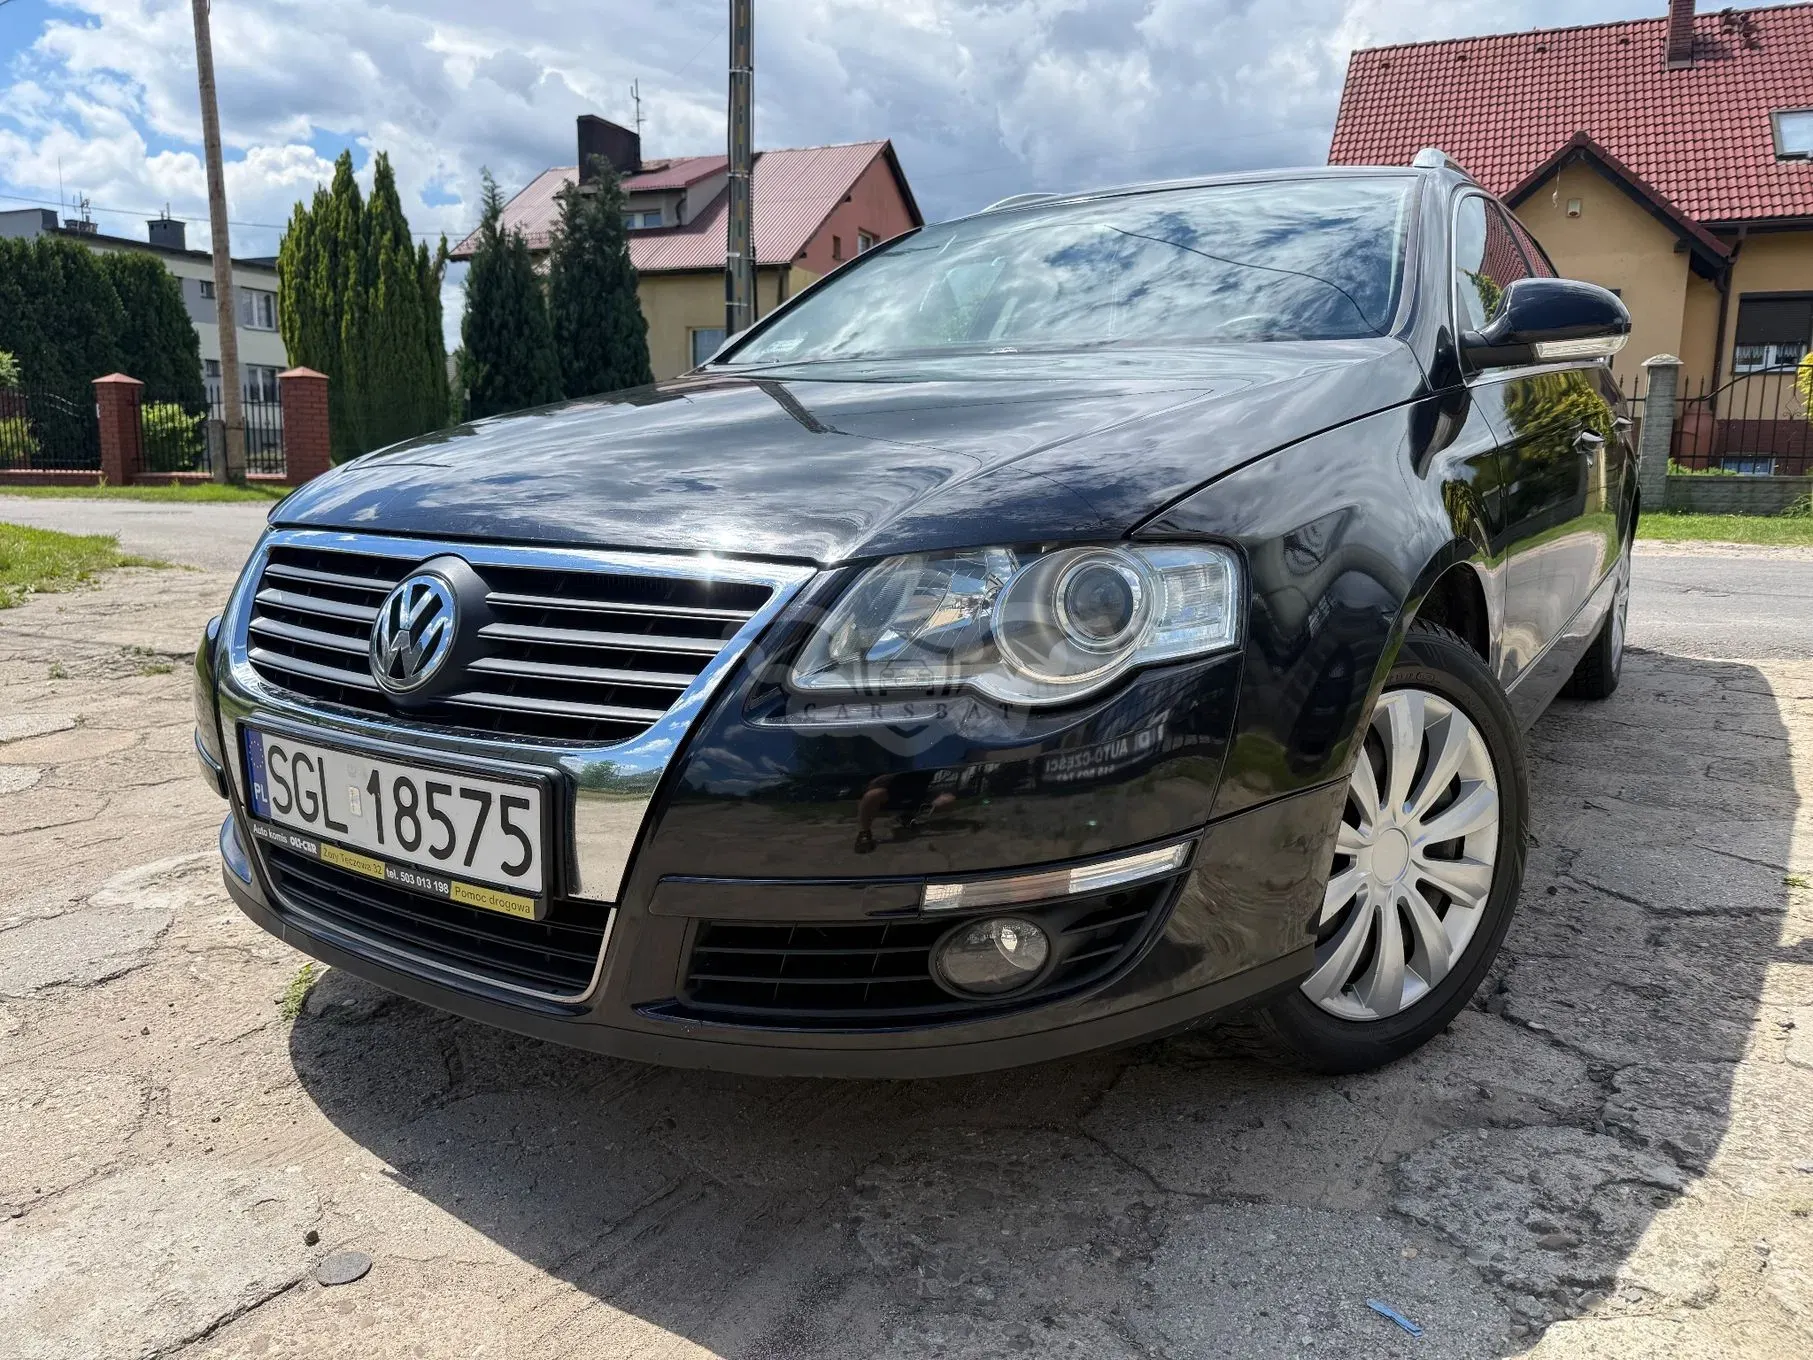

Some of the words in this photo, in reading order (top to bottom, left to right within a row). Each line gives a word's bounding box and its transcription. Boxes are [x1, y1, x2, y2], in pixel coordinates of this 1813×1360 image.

[254, 783, 268, 803] PL
[267, 744, 349, 834] SGL
[366, 768, 533, 878] 18575
[253, 823, 268, 837] Auto
[269, 828, 288, 843] komis
[372, 862, 383, 875] 32
[385, 867, 399, 880] tel.
[400, 871, 415, 885] 503
[416, 875, 432, 889] 013
[433, 880, 449, 895] 198
[454, 885, 487, 903] Pomoc
[488, 894, 531, 914] drogowa
